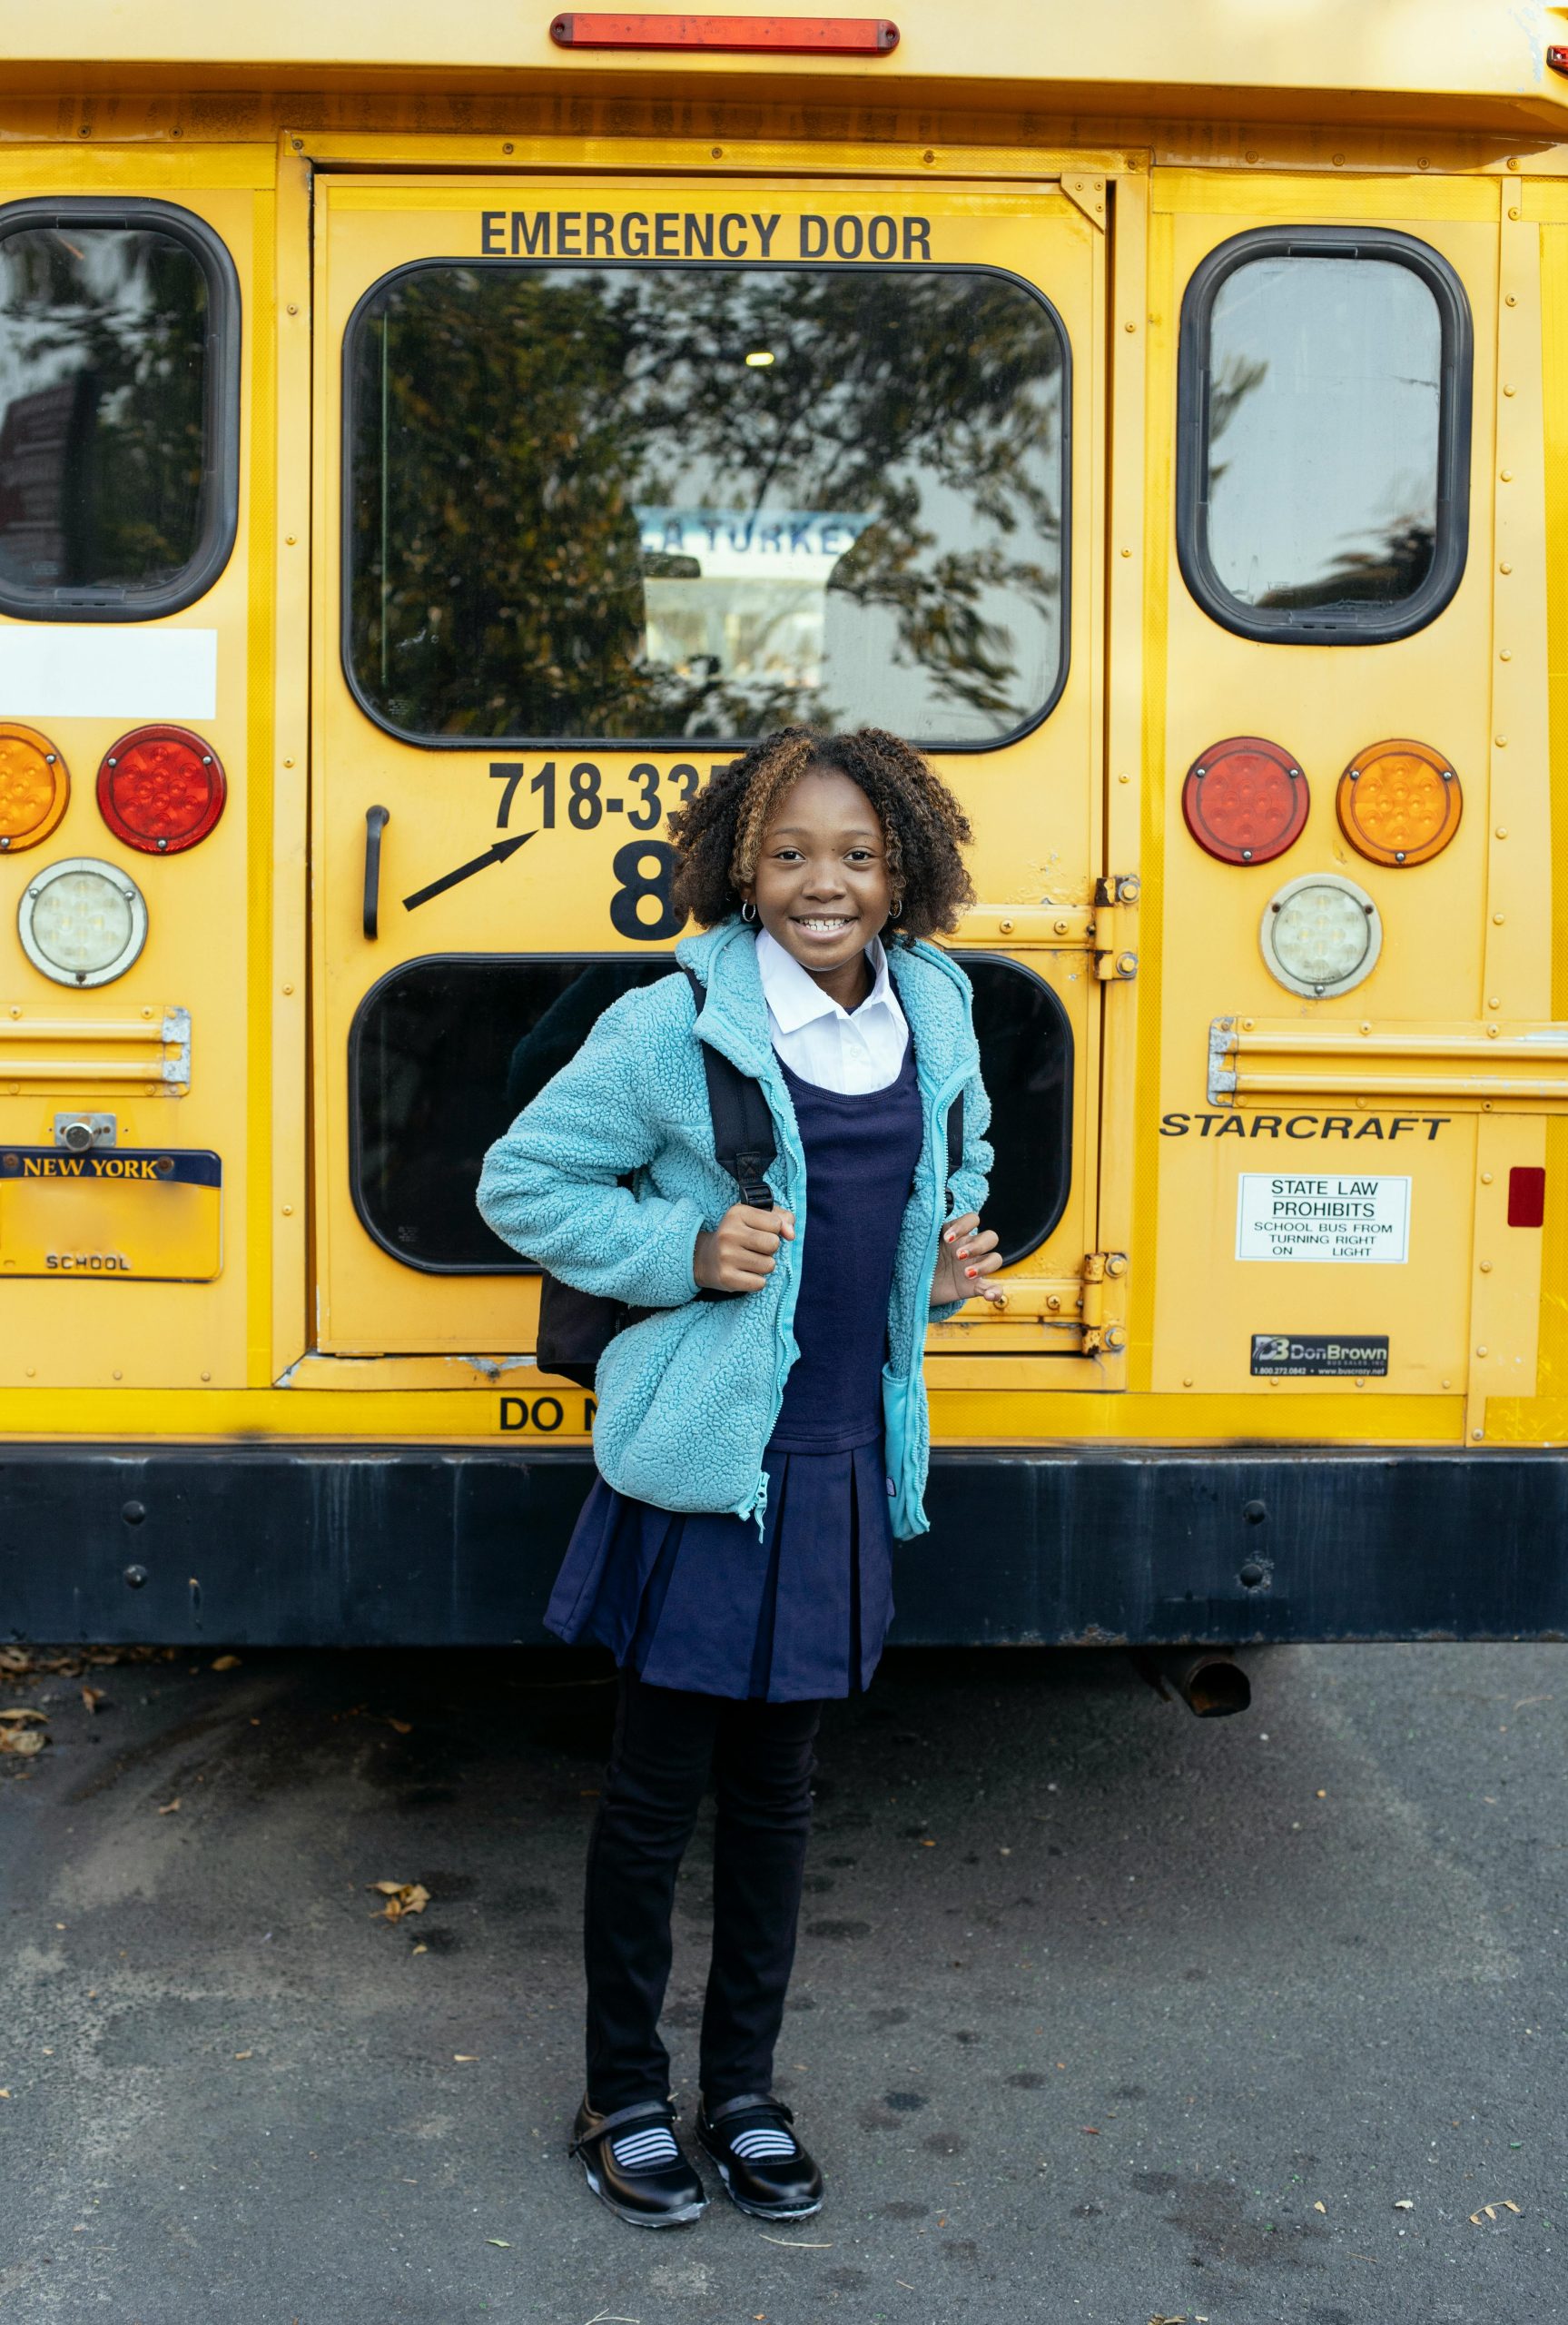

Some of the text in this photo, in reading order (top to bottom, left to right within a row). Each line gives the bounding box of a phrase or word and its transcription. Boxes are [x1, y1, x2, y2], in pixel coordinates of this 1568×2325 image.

[480, 211, 932, 261] EMERGENCY DOOR
[489, 762, 730, 830] 718-33
[1159, 1113, 1451, 1141] STARCRAFT
[23, 1157, 158, 1180] NEW YORK
[1271, 1179, 1378, 1195] STATE LAW
[1273, 1202, 1375, 1218] PROHIBITS
[1254, 1222, 1393, 1233] SCHOOL BUS FROM
[1269, 1233, 1376, 1245] TURNING RIGHT
[1272, 1245, 1372, 1257] ON LIGHT
[46, 1255, 130, 1271] SCHOOL
[500, 1397, 564, 1431] DO
